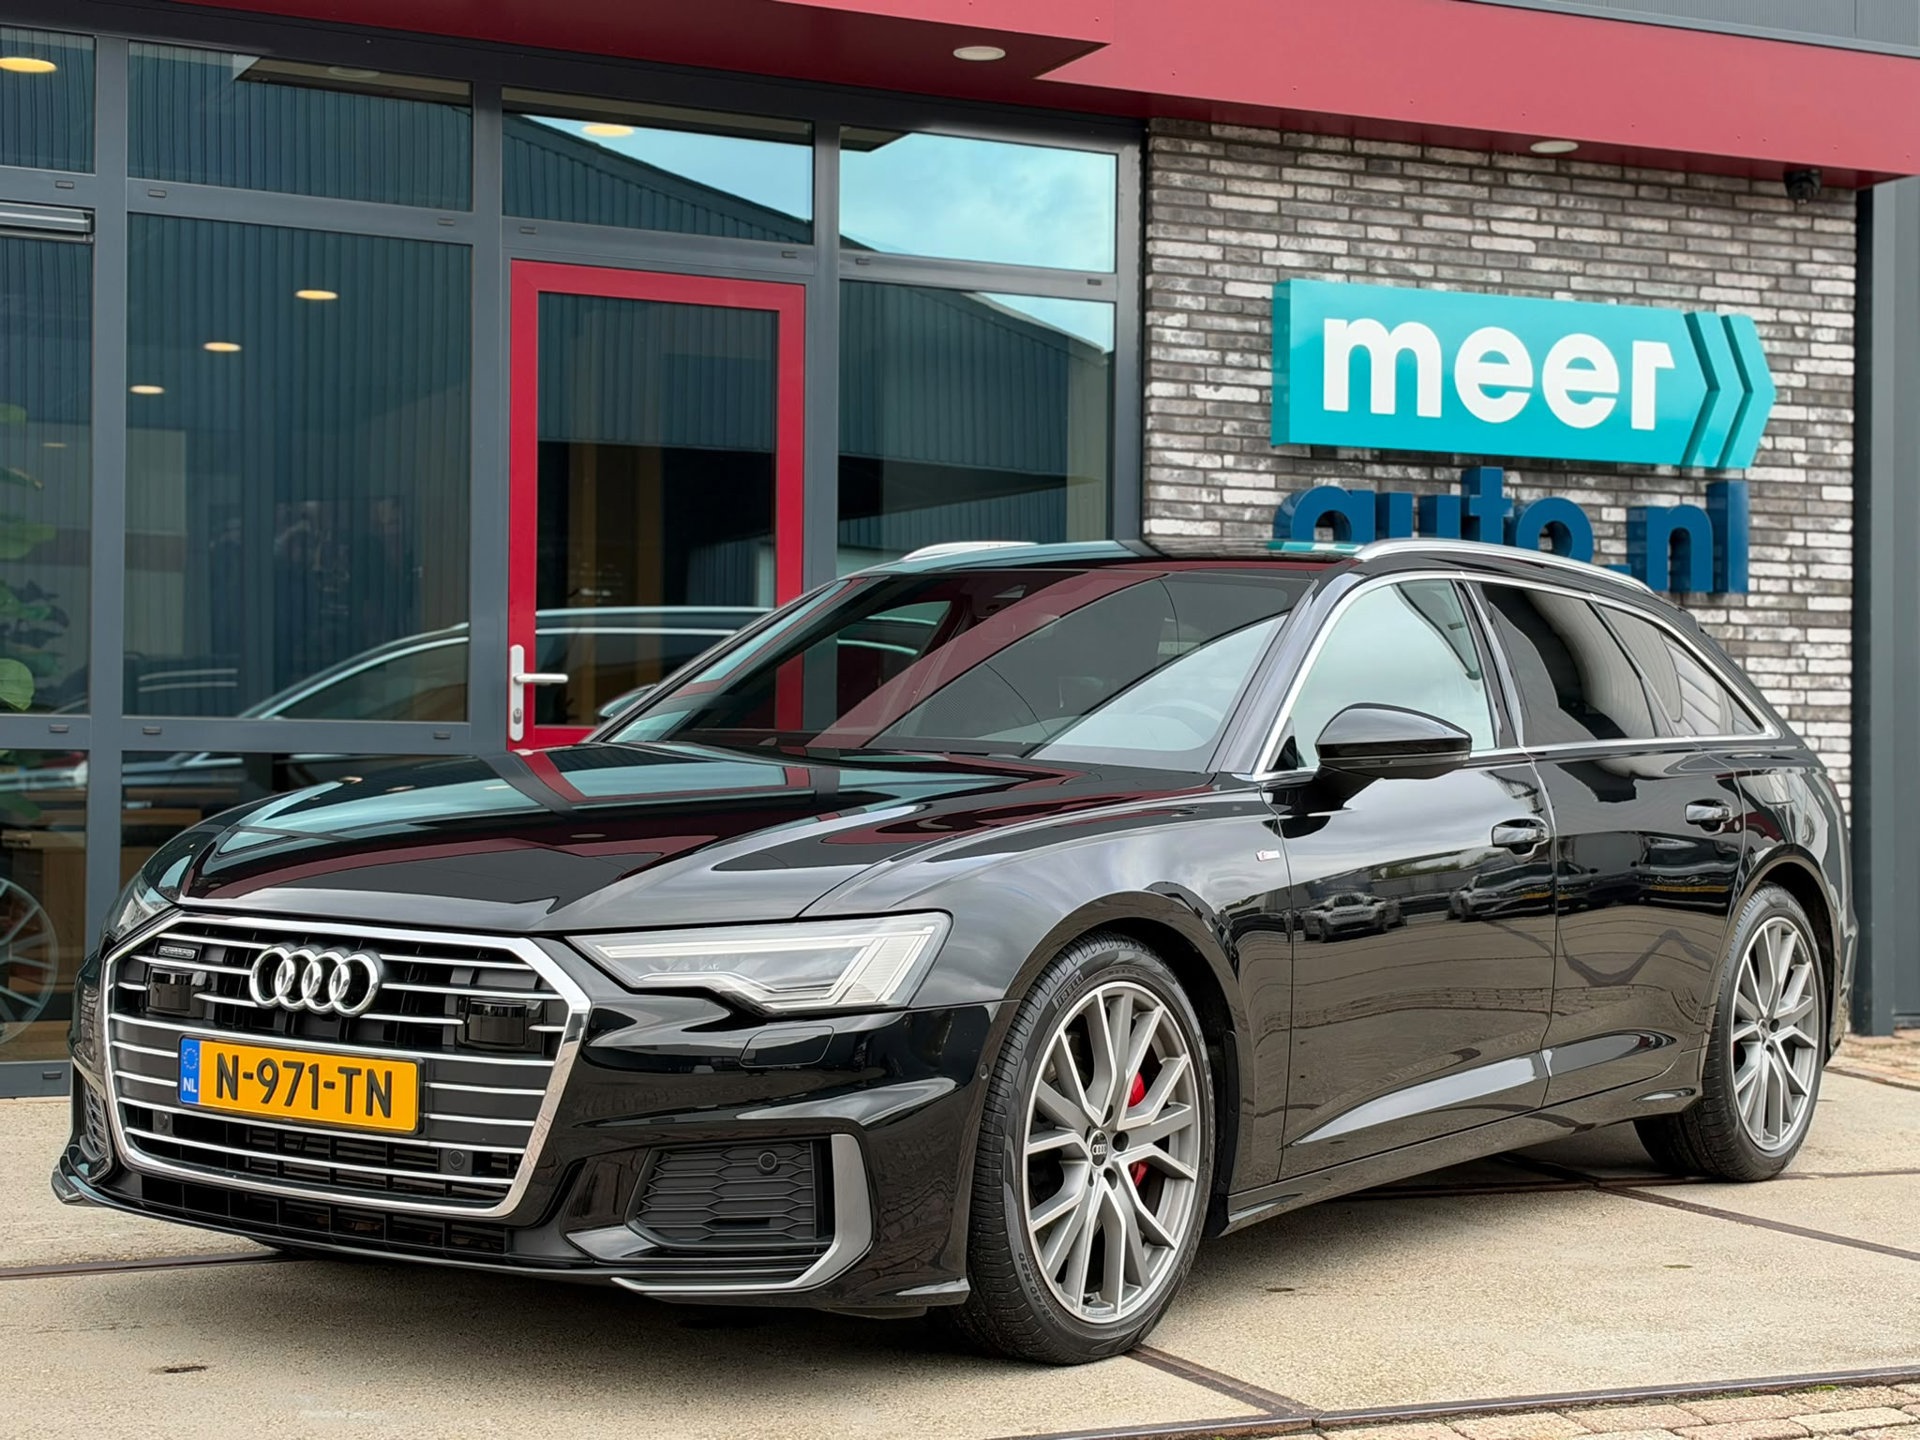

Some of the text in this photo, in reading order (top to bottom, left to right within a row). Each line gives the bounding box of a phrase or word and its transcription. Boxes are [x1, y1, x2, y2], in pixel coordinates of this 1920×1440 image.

[1323, 318, 1676, 430] meer
[183, 1077, 197, 1093] NL
[216, 1052, 392, 1118] N-971-TN
